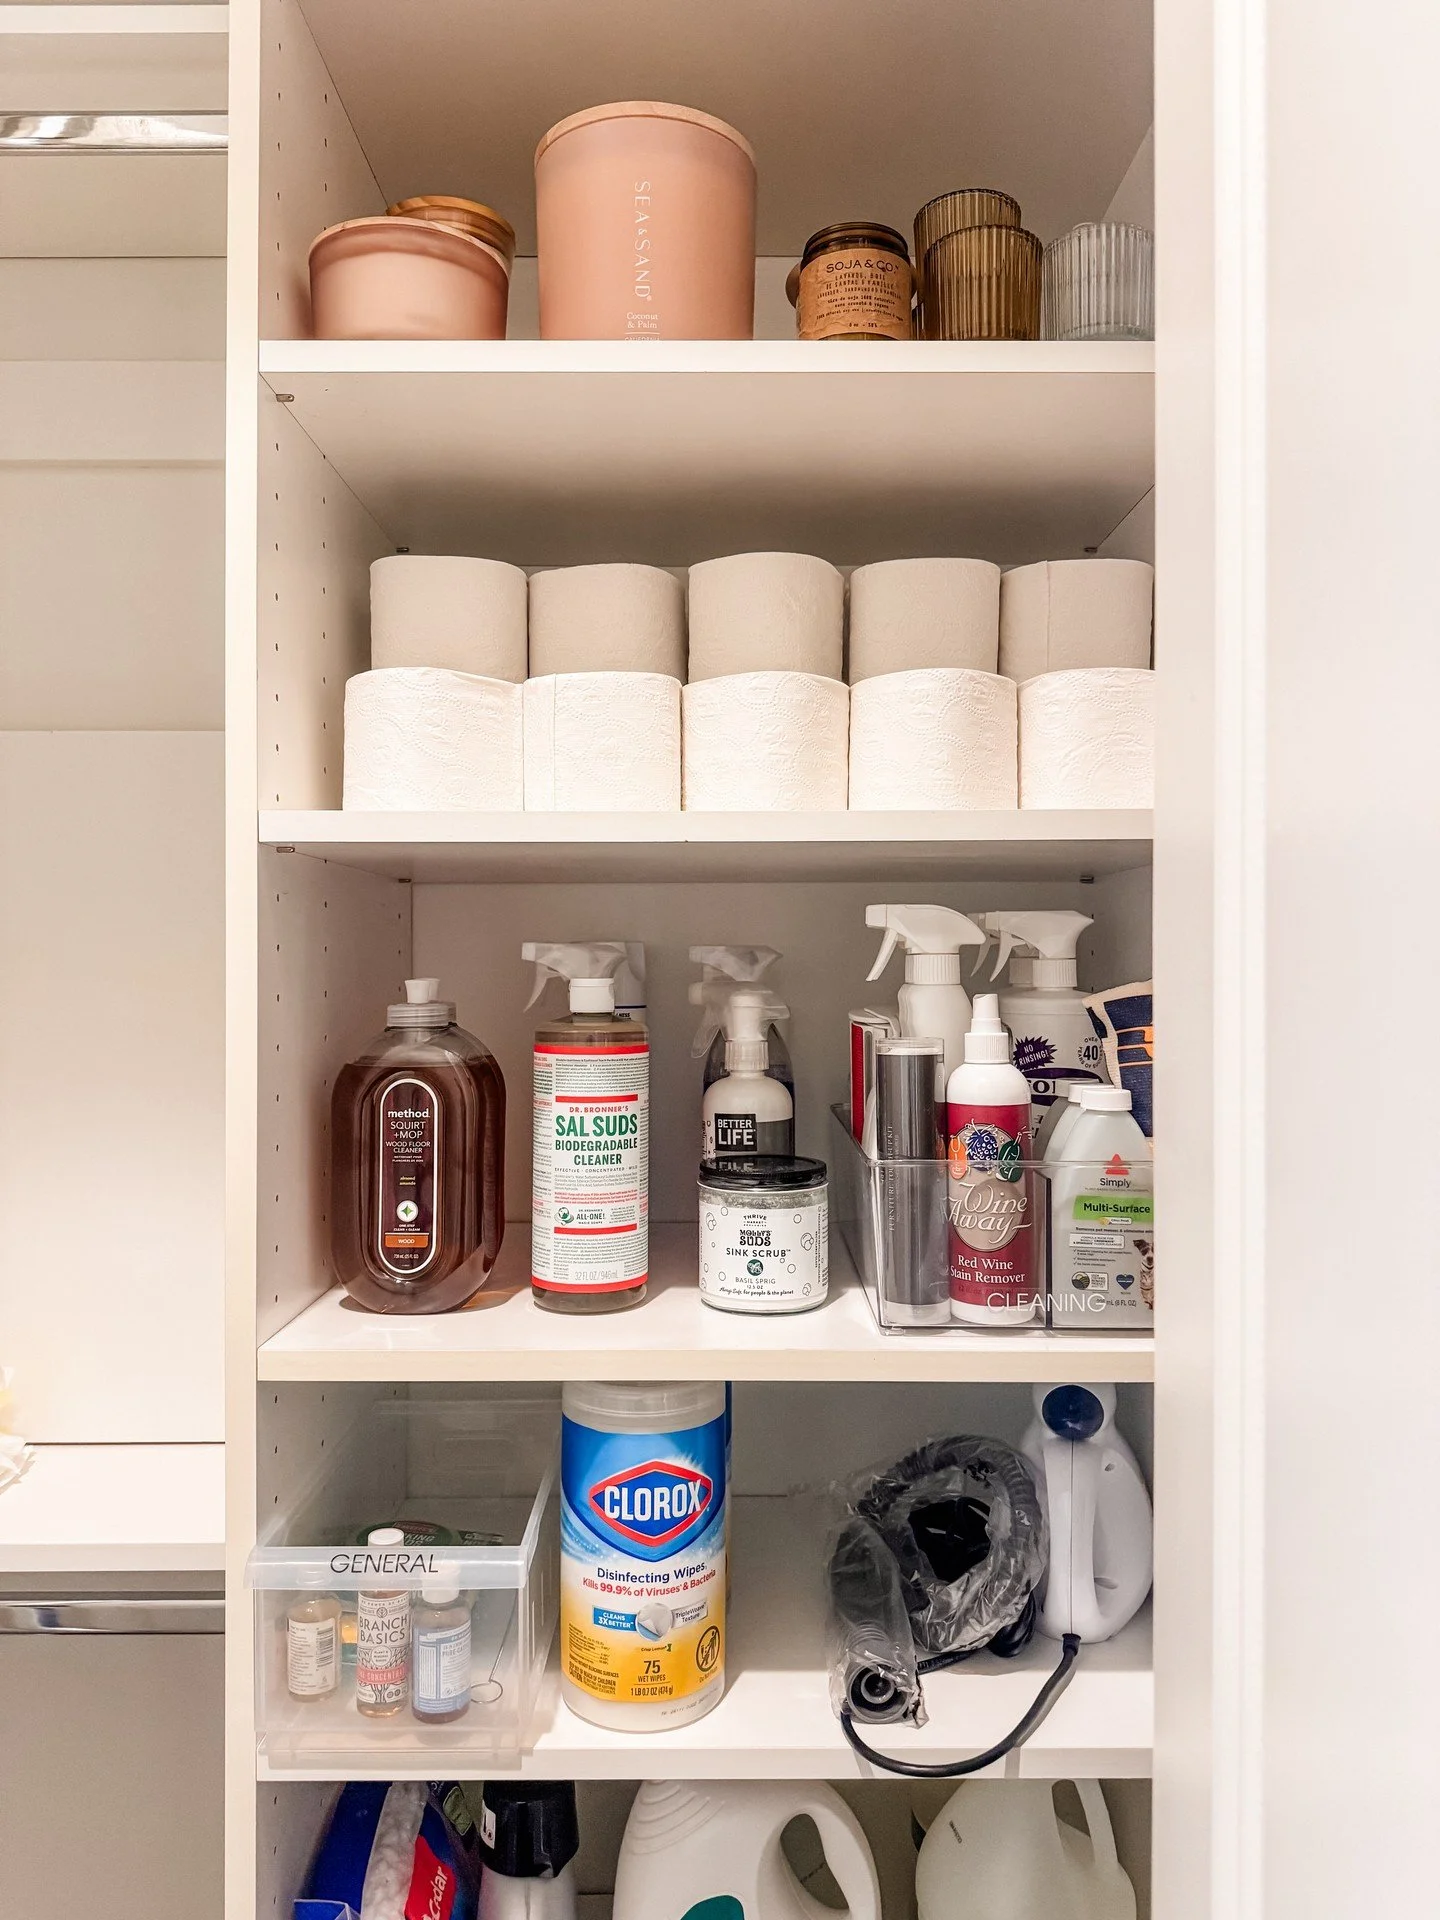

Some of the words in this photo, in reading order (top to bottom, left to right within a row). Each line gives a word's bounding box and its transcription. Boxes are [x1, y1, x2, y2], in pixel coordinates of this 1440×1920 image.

[626, 312, 658, 320] Coconut
[637, 320, 658, 328] Palm
[1024, 1044, 1034, 1054] NO
[1083, 1045, 1098, 1060] 40
[1018, 1049, 1050, 1066] RINSING!
[390, 1121, 426, 1130] SQUIRT
[555, 1114, 590, 1138] SAL
[592, 1113, 638, 1138] SUDS
[718, 1118, 752, 1128] BETTER
[394, 1130, 423, 1139] +MOP
[718, 1128, 754, 1146] LIFE
[555, 1138, 638, 1152] BIODEGRADABLE
[574, 1154, 622, 1166] CLEANER
[1100, 1178, 1132, 1188] Simply
[959, 1182, 1028, 1214] Wine
[1084, 1202, 1150, 1214] Multi-Surface
[948, 1196, 1032, 1244] Away
[740, 1236, 772, 1246] SUDS
[726, 1248, 749, 1257] SINK
[752, 1250, 786, 1258] SCRUB
[958, 1254, 978, 1268] Red
[982, 1258, 1014, 1270] Wine
[950, 1266, 972, 1281] Stain
[976, 1272, 1026, 1284] Remover
[986, 1292, 1106, 1312] CLEANING
[604, 1479, 702, 1522] CLOROX
[330, 1554, 438, 1574] GENERAL
[597, 1568, 670, 1584] Disinfecting
[674, 1562, 705, 1580] Wipes
[582, 1577, 599, 1590] Kills
[600, 1582, 632, 1596] 99.9%
[634, 1588, 644, 1597] of
[682, 1582, 689, 1590] &
[690, 1569, 716, 1588] Bacteria
[360, 1614, 408, 1631] BRANCH
[598, 1616, 608, 1626] 3X
[608, 1620, 631, 1628] BETTER
[602, 1612, 626, 1620] CLEANS
[360, 1628, 405, 1644] BASICS
[644, 1660, 661, 1674] 75
[635, 1688, 642, 1696] LB
[650, 1687, 658, 1696] OZ
